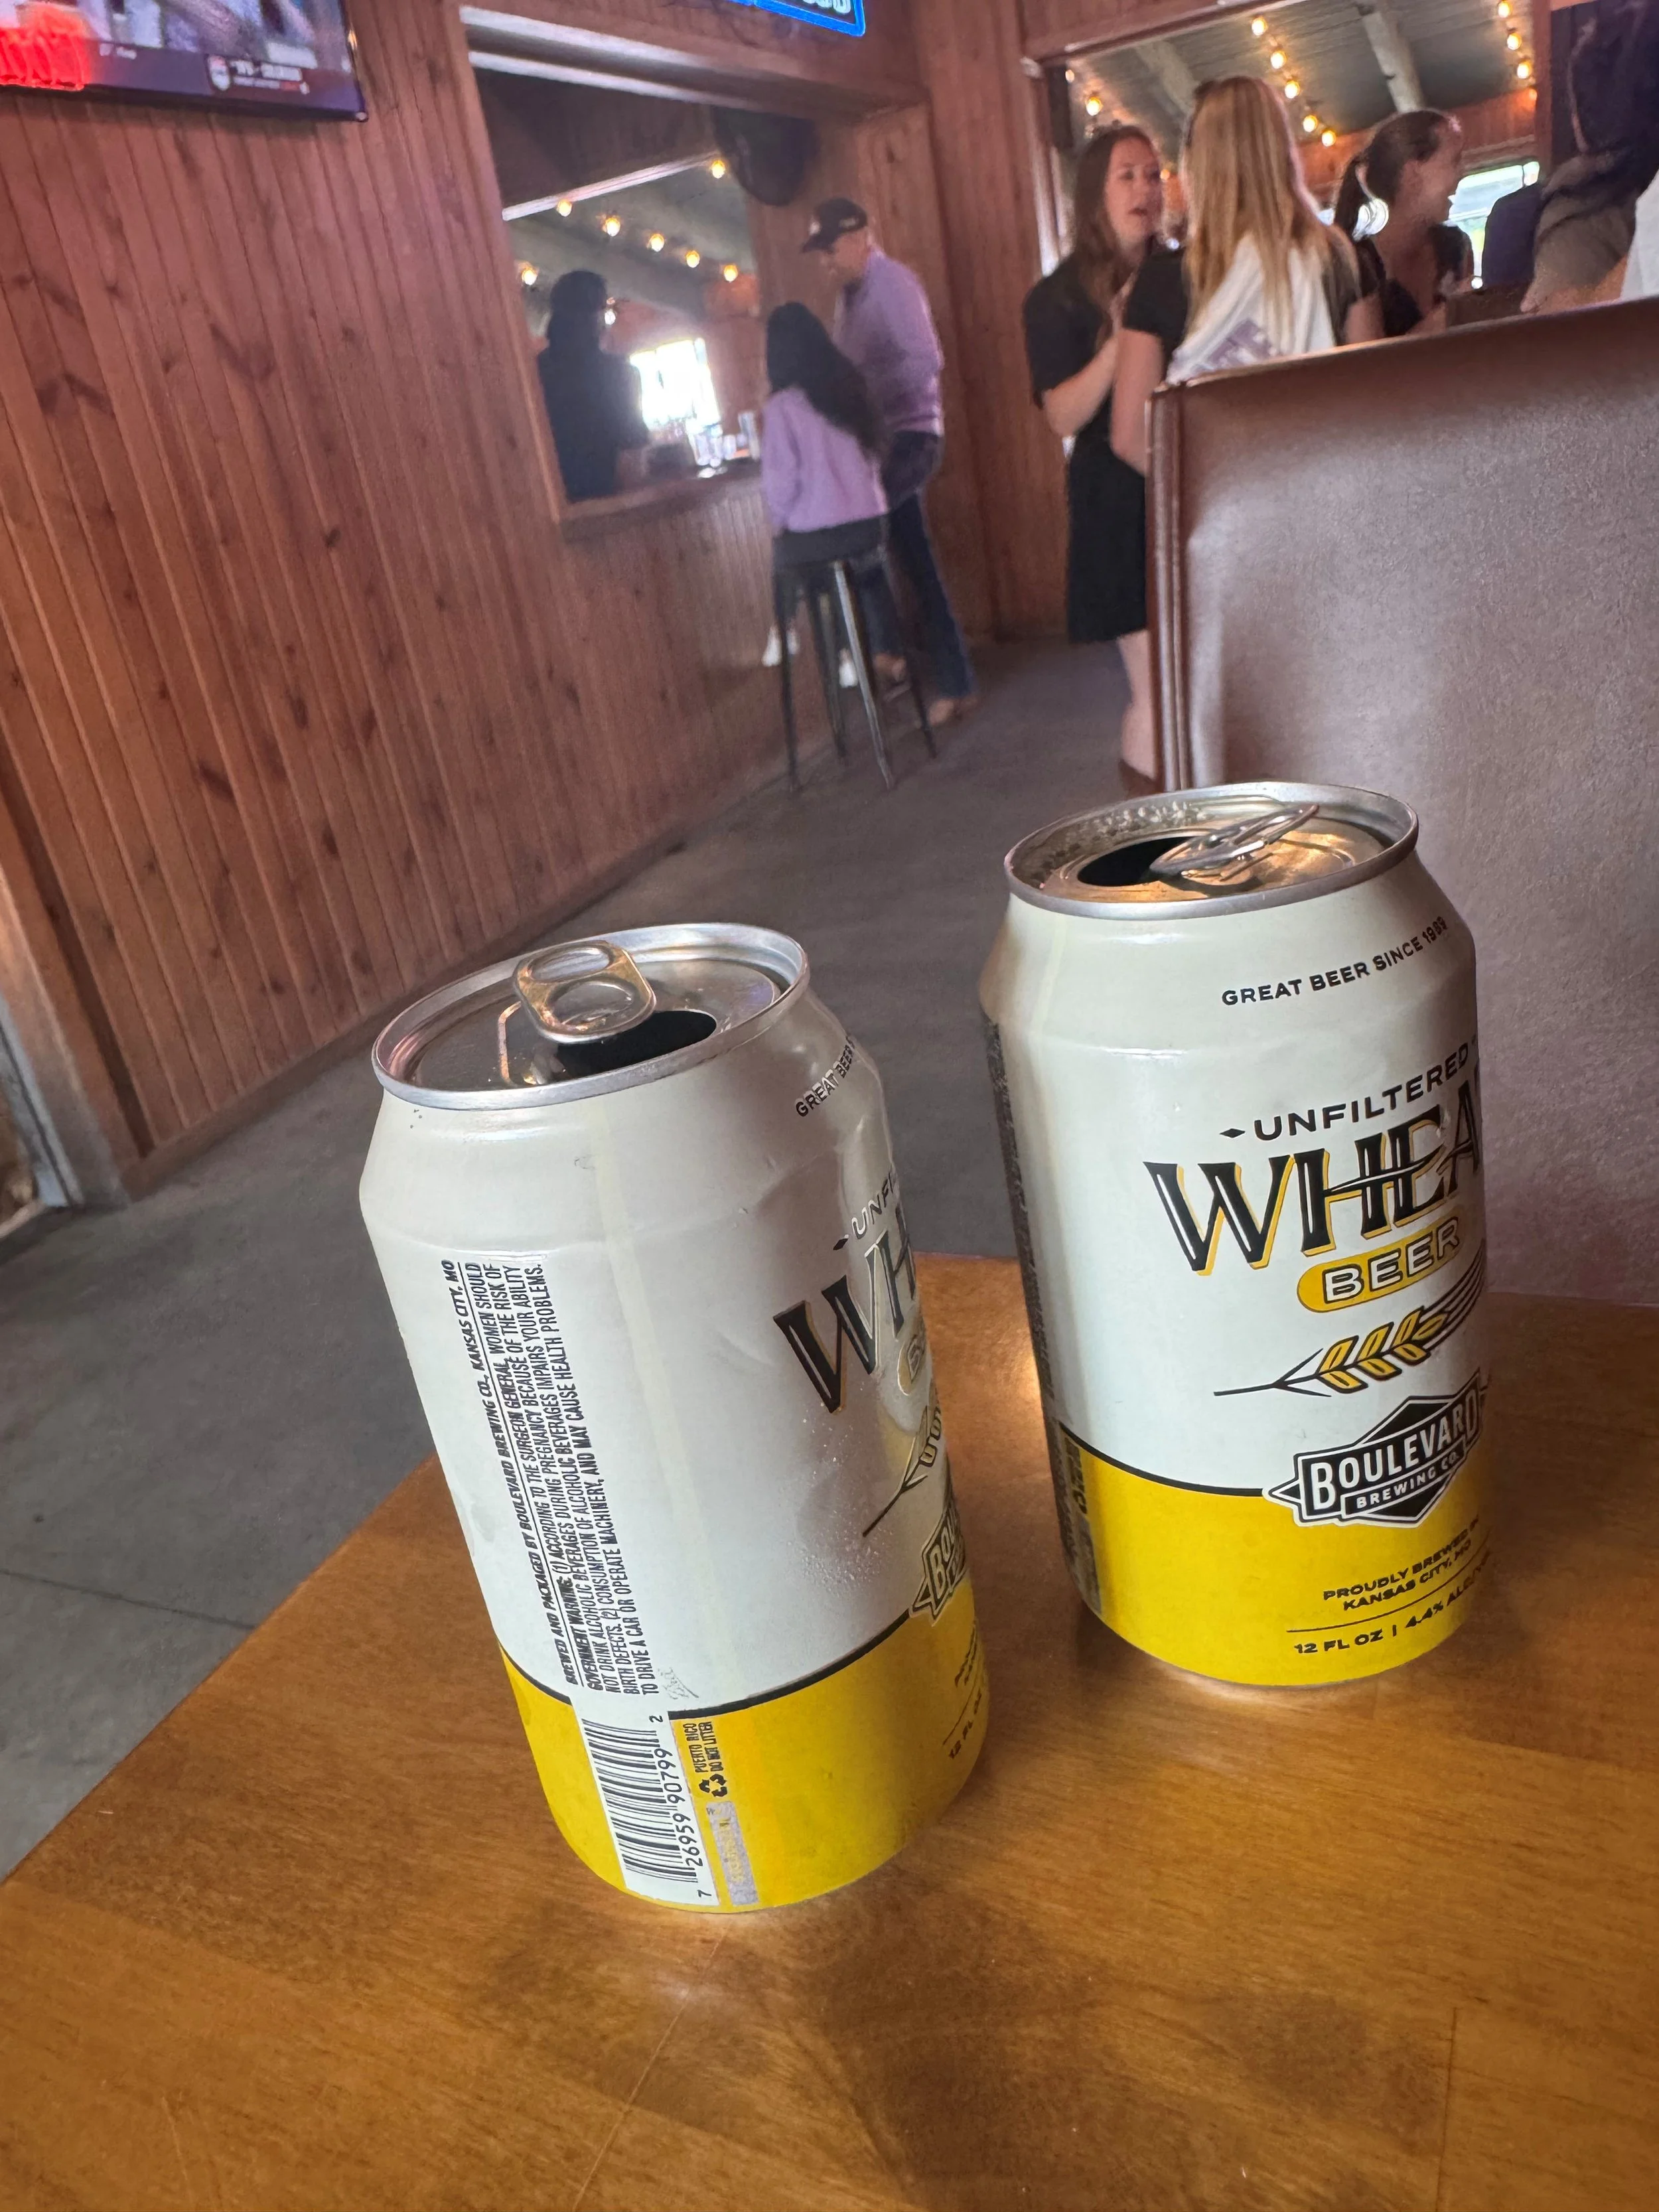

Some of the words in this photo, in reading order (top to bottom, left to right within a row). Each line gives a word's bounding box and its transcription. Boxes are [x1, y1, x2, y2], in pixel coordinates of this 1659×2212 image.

[1222, 979, 1303, 1005] GREAT
[1309, 962, 1370, 992] BEER
[1372, 936, 1423, 971] SINCE
[796, 1069, 839, 1116] GREAT
[1254, 1043, 1469, 1140] UNFILTERED
[1143, 1069, 1481, 1276] WHEA
[441, 1260, 459, 1282] MO
[483, 1264, 501, 1279] OF
[1323, 1216, 1460, 1304] BEER
[449, 1286, 468, 1317] CITY,
[465, 1263, 492, 1309] SHOULD
[487, 1283, 512, 1309] RISK
[502, 1266, 532, 1307] ABILITY
[524, 1264, 559, 1332] PROBLEMS.
[459, 1319, 484, 1370] KANSAS
[478, 1311, 505, 1354] WOMEN
[497, 1314, 518, 1335] THE
[517, 1312, 540, 1341] YOUR
[504, 1339, 524, 1353] OF
[544, 1338, 573, 1380] HEALTH
[493, 1358, 521, 1409] GENERAL,
[510, 1357, 539, 1406] BECAUSE
[526, 1346, 555, 1390] IMPAIRS
[557, 1384, 584, 1420] CAUSE
[482, 1400, 510, 1457] BREWING
[507, 1411, 536, 1461] SURGEON
[524, 1410, 559, 1474] PREGNANCY
[540, 1394, 573, 1454] BEVERAGES
[568, 1426, 591, 1448] MAY
[577, 1453, 600, 1475] AND
[1310, 1388, 1477, 1510] BOULEVARD
[523, 1463, 541, 1483] THE
[530, 1487, 547, 1497] TO
[558, 1457, 590, 1514] ALCOHOLIC
[1356, 1469, 1436, 1509] BREWING
[501, 1460, 532, 1530] BOULEVARD
[545, 1479, 571, 1518] DURING
[584, 1479, 617, 1544] MACHINERY,
[522, 1532, 538, 1550] BY
[534, 1501, 565, 1560] ACCORDING
[574, 1517, 594, 1529] OF
[550, 1561, 572, 1574] (1)
[557, 1522, 589, 1581] BEVERAGES
[579, 1533, 614, 1604] CONSUMPTION
[603, 1549, 632, 1594] OPERATE
[528, 1552, 556, 1611] PACKAGED
[1323, 1568, 1409, 1600] PROUDLY
[1344, 1580, 1416, 1611] KANSAS
[547, 1612, 564, 1637] AND
[575, 1584, 606, 1639] ALCOHOLIC
[599, 1608, 620, 1619] (2)
[618, 1599, 636, 1612] OR
[605, 1624, 631, 1664] DEFECTS.
[622, 1617, 643, 1636] CAR
[1295, 1643, 1318, 1653] 12
[1323, 1639, 1350, 1651] FL
[1354, 1628, 1384, 1646] OZ
[554, 1638, 578, 1685] BREWED
[570, 1625, 603, 1690] GOVERNMENT
[592, 1641, 615, 1672] DRINK
[631, 1650, 655, 1679] DRIVE
[601, 1673, 621, 1692] NOT
[618, 1668, 640, 1694] BIRTH
[641, 1684, 659, 1695] TO
[683, 1723, 698, 1741] RICO
[699, 1722, 717, 1745] LITTER
[654, 1748, 685, 1804] 90799
[688, 1744, 708, 1773] PUERTO
[708, 1762, 723, 1771] DO
[672, 1813, 703, 1866] 26959
